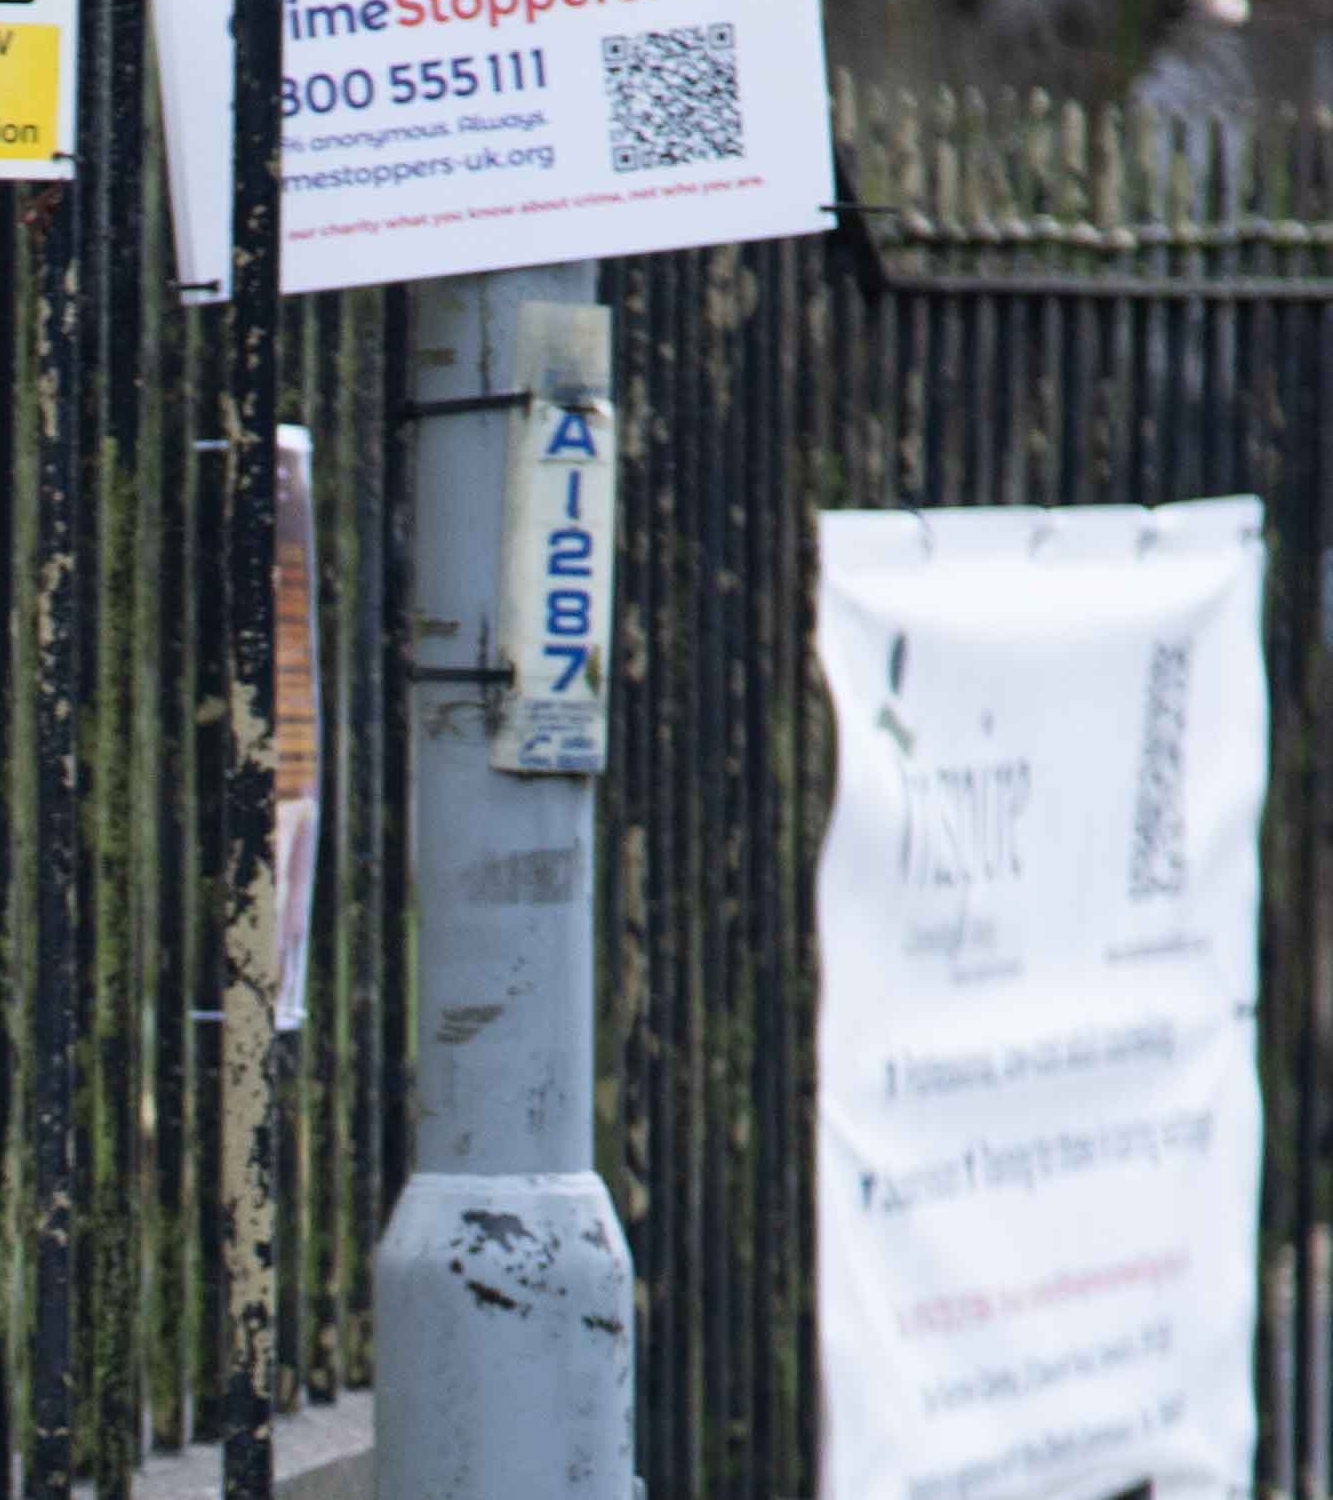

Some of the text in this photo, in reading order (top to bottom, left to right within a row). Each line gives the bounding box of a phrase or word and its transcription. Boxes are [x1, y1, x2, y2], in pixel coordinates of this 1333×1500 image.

[279, 66, 374, 117] 800
[280, 144, 555, 193] mestoppers-uk.org
[541, 412, 597, 693] A1287
